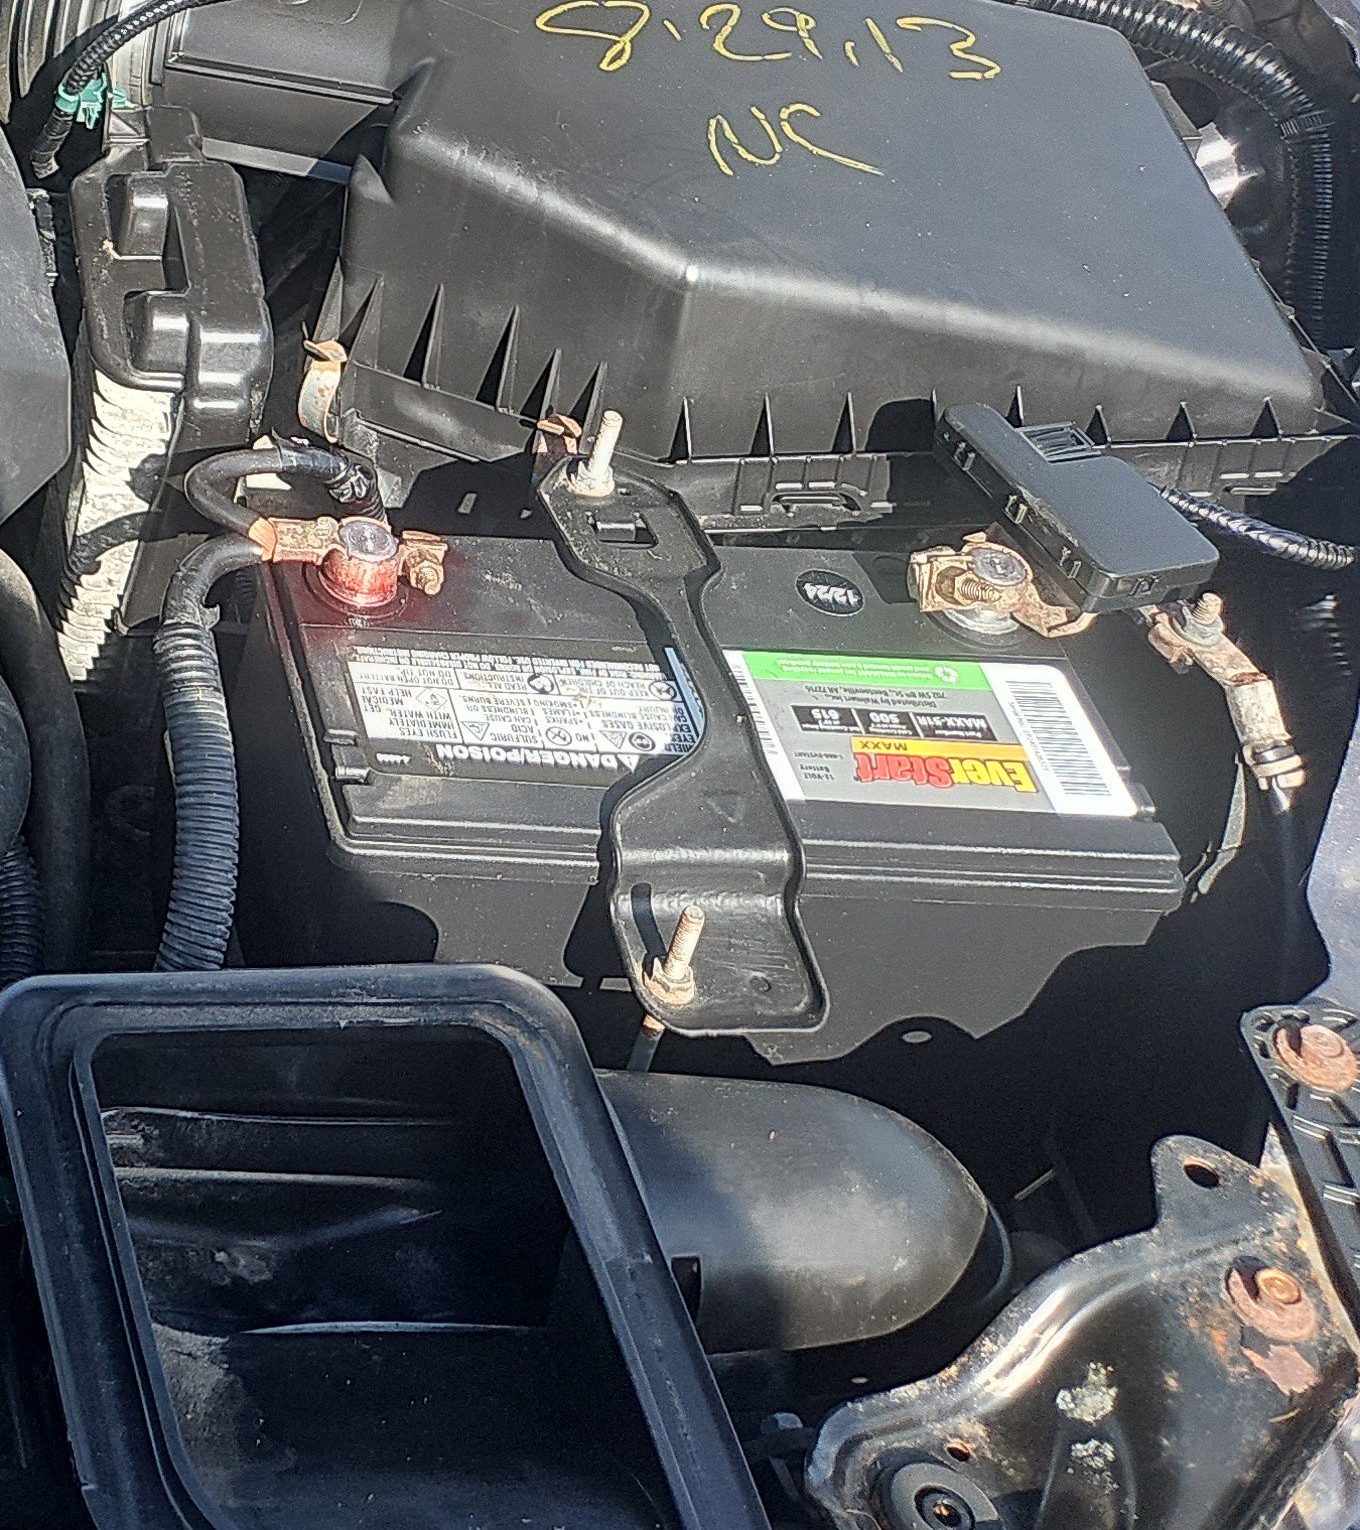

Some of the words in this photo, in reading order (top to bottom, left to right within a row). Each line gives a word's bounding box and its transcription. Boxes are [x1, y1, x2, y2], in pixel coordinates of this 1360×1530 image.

[803, 580, 861, 606] 12/24
[360, 695, 404, 705] MEDICAL
[844, 695, 879, 705] Walmart
[879, 697, 891, 706] by
[891, 698, 937, 709] Distributed
[362, 704, 381, 713] GET
[426, 710, 451, 720] WITH
[810, 708, 839, 720] 615
[868, 711, 900, 724] 500
[388, 717, 454, 729] IMMEDIATELY
[601, 719, 634, 729] GASES
[915, 714, 987, 730] MAXX-51R
[398, 727, 423, 737] EYES
[511, 723, 534, 733] ACID
[426, 729, 457, 739] FLUSH
[489, 732, 538, 744] SULFURIC
[575, 732, 589, 742] NO
[859, 740, 909, 752] MAXX
[854, 752, 1038, 795] EverStart
